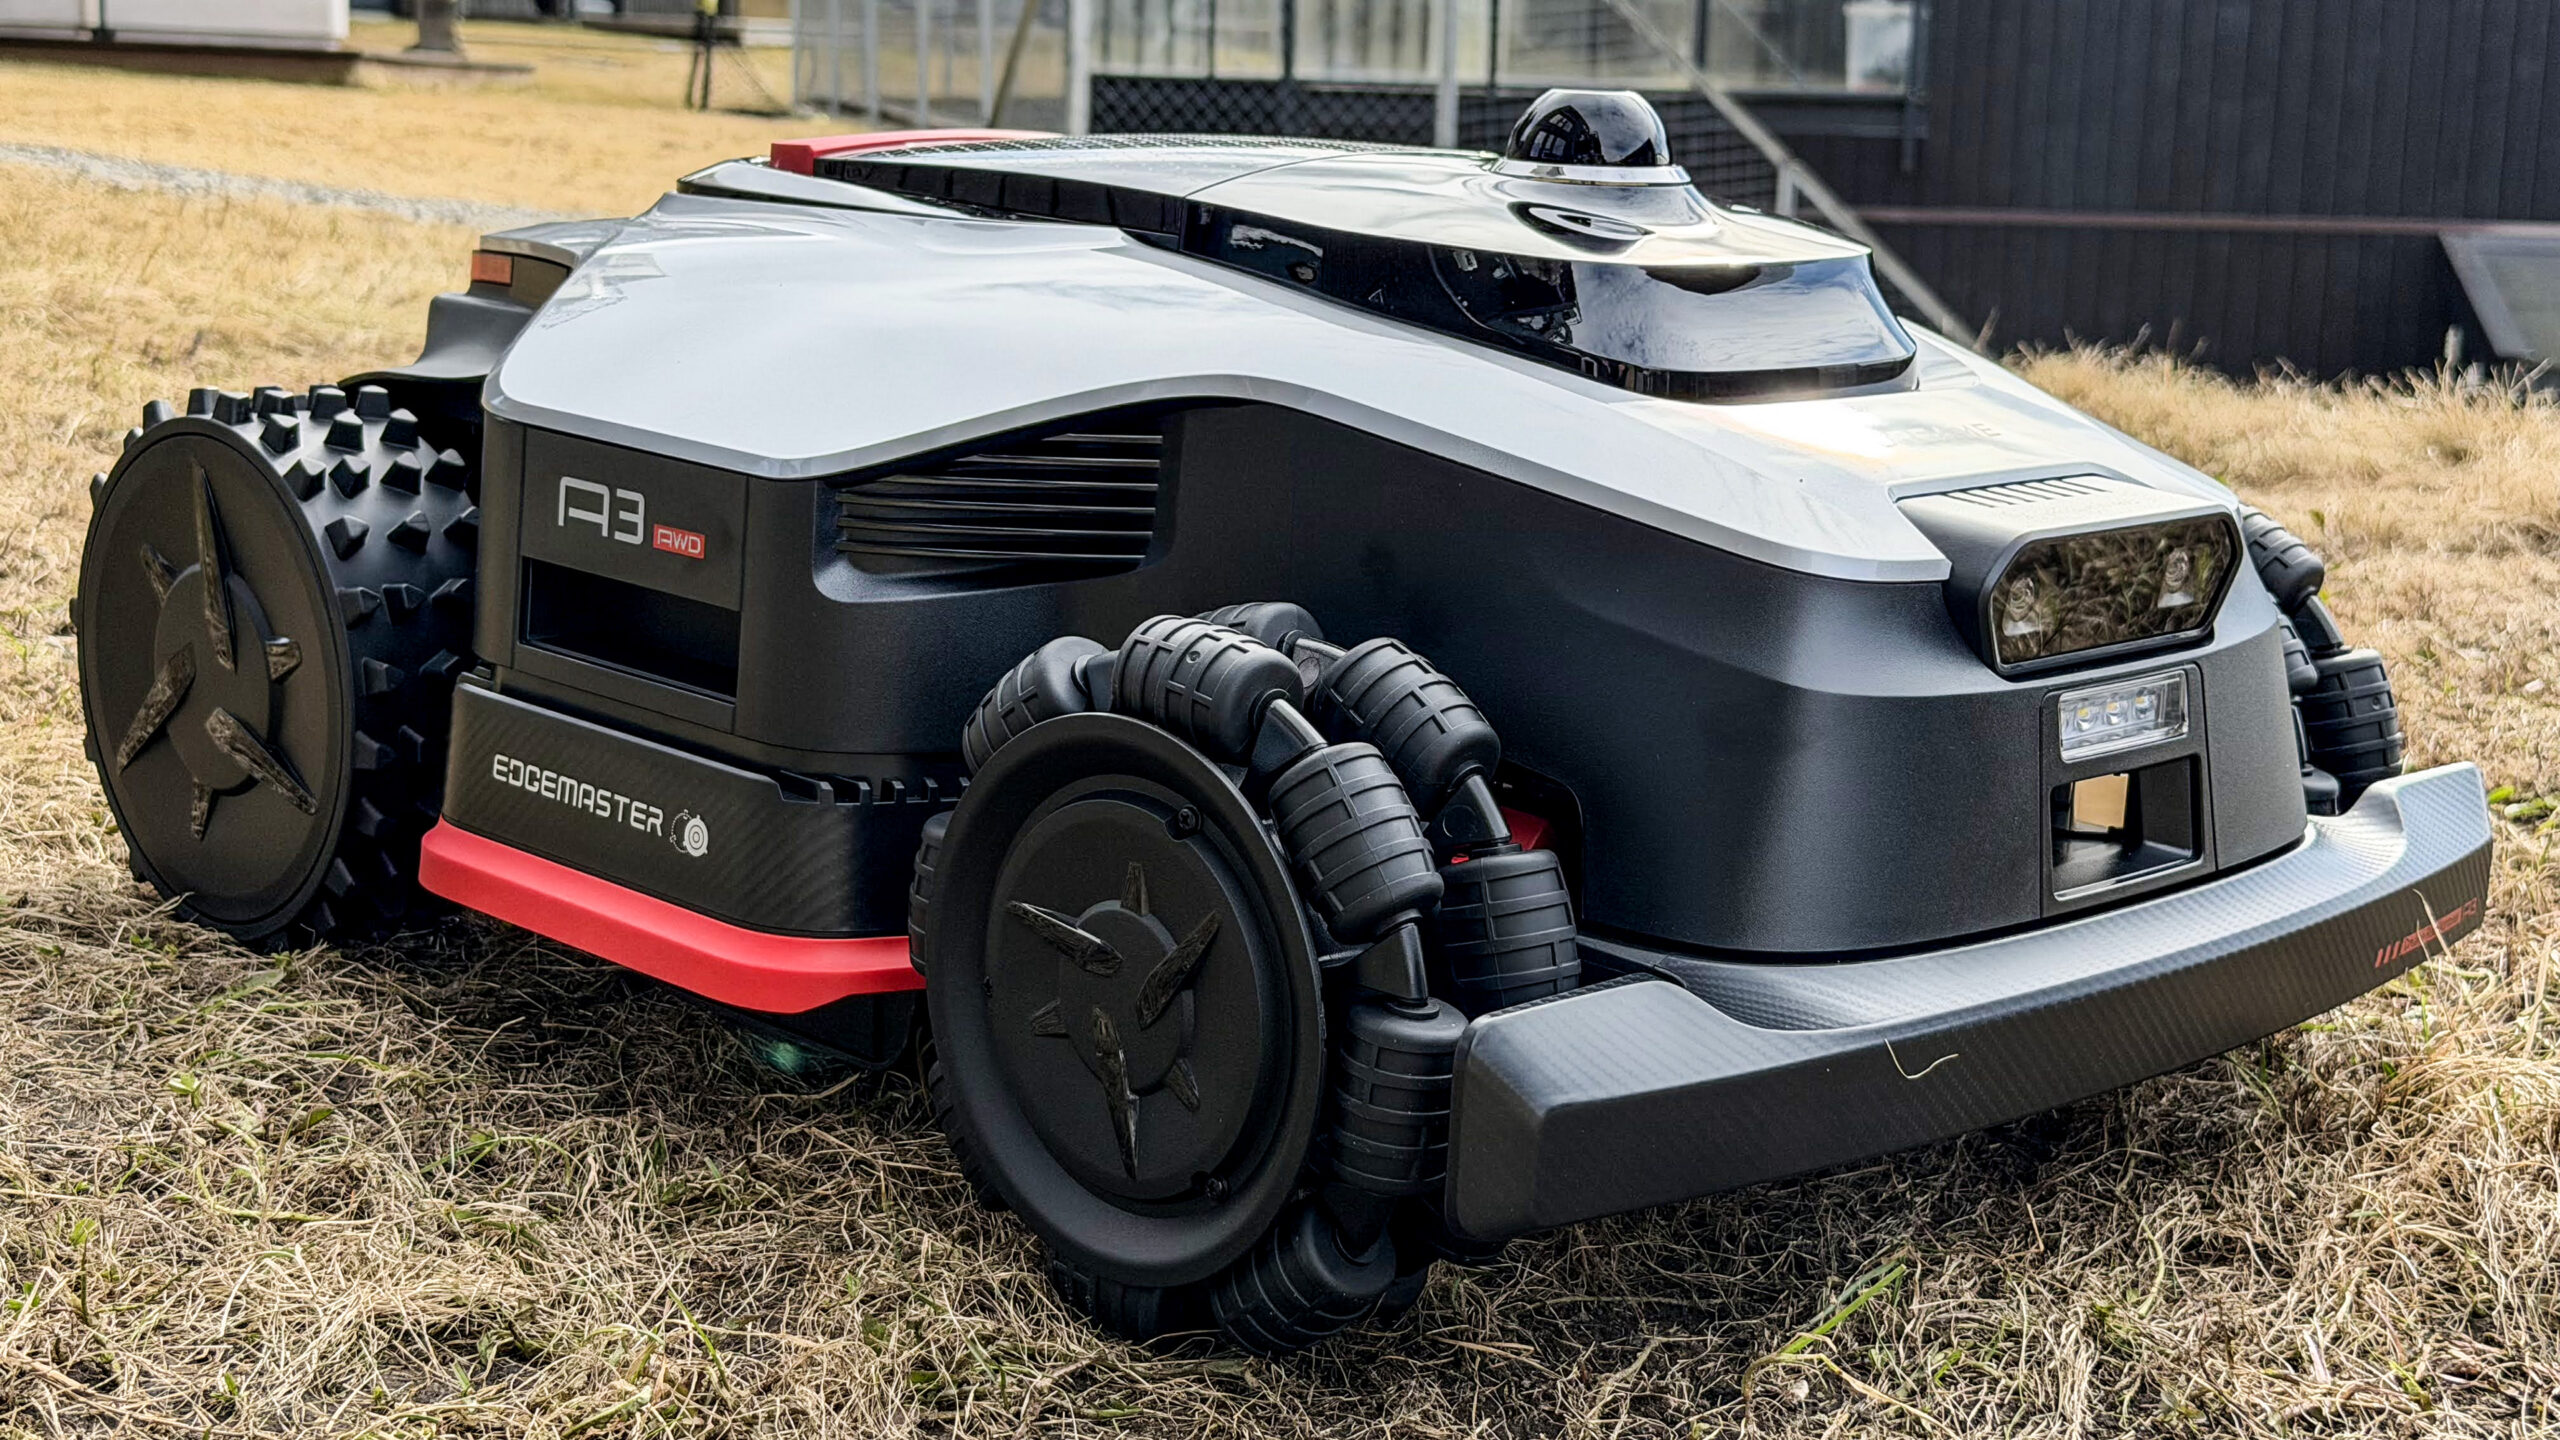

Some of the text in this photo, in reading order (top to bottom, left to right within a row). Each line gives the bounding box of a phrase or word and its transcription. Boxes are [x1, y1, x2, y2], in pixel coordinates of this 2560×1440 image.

[558, 476, 702, 554] A3 AWD
[492, 753, 664, 837] EDGEMASTER
